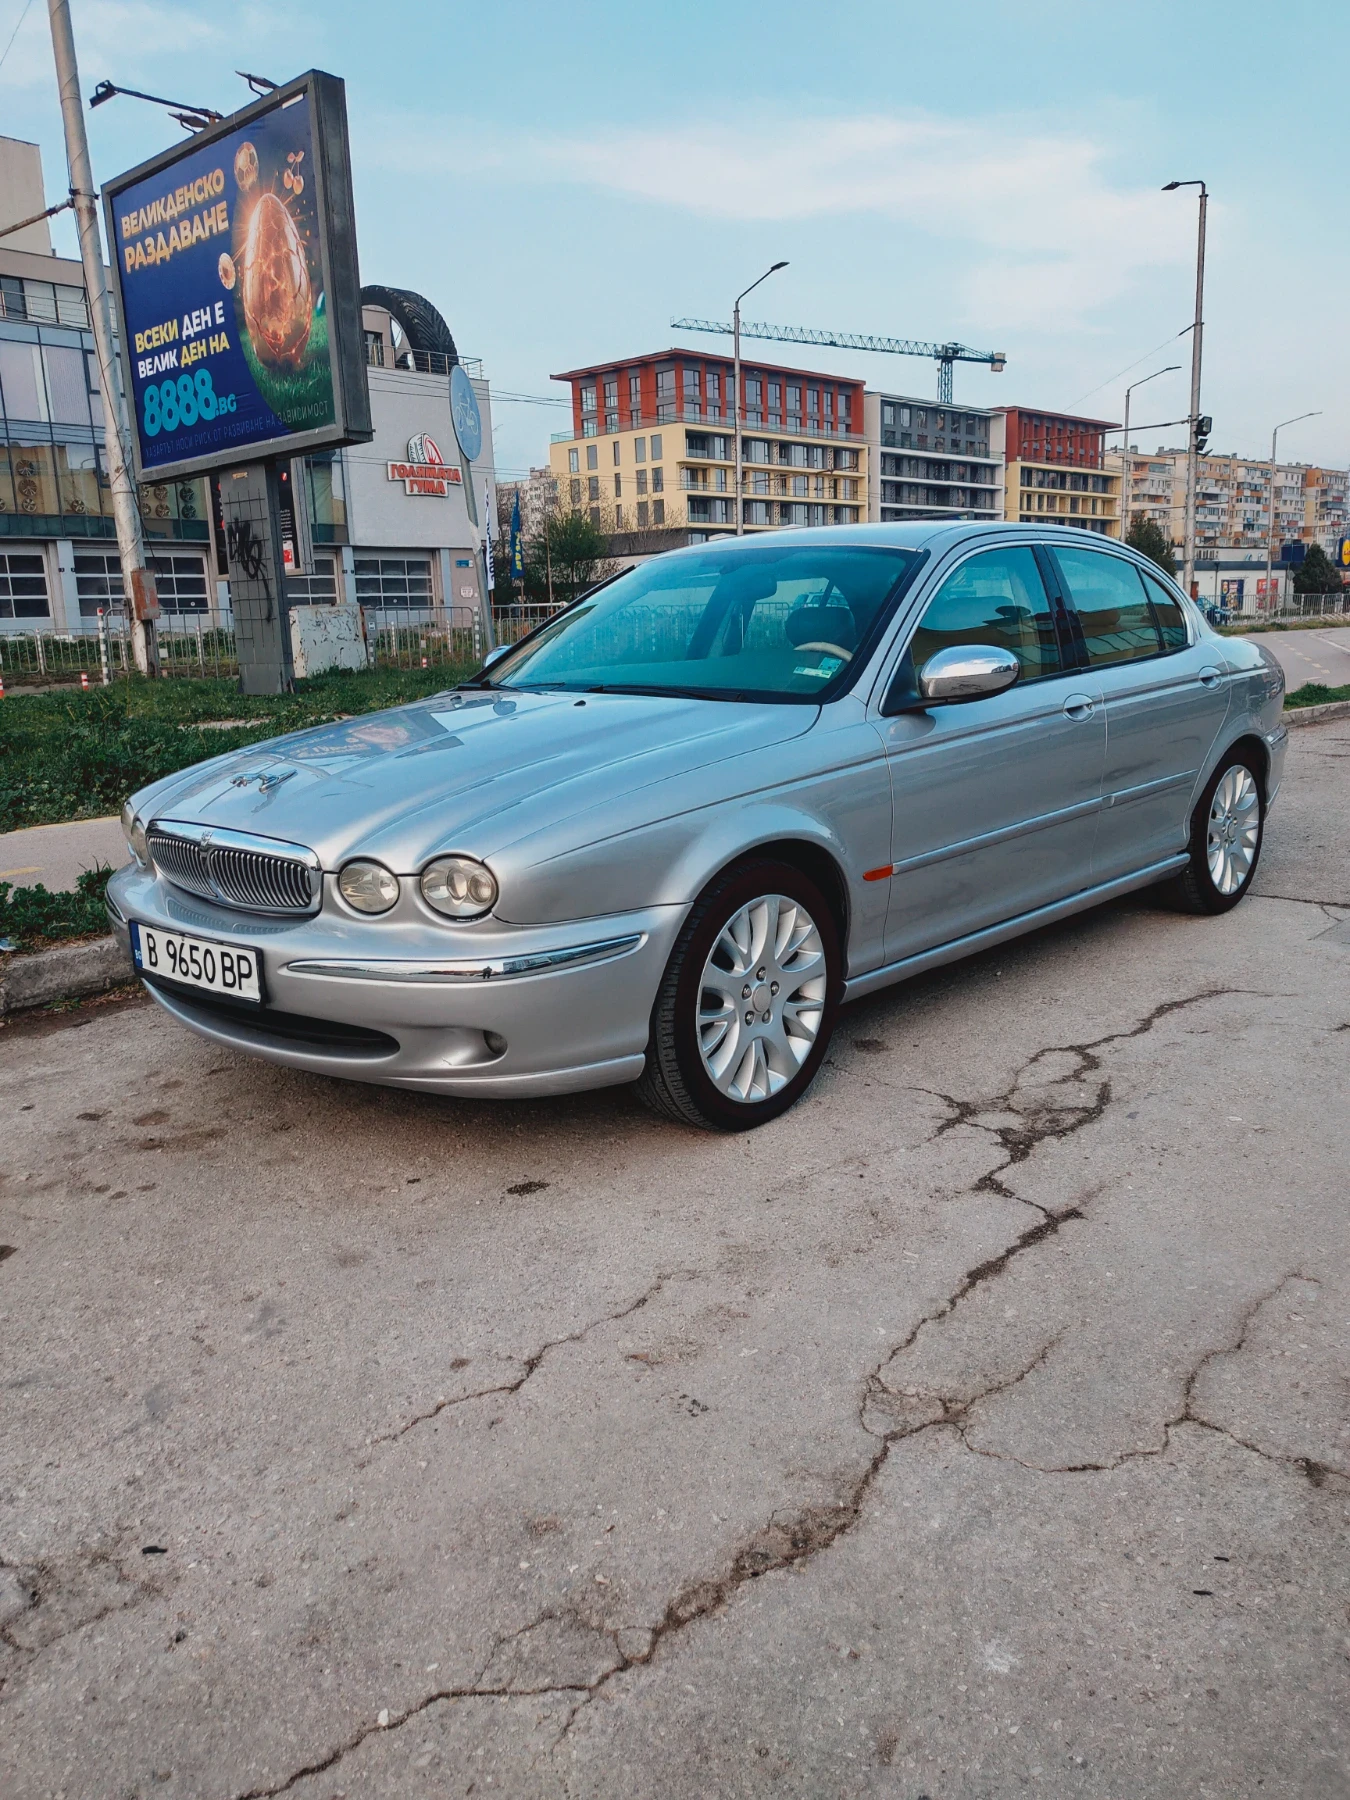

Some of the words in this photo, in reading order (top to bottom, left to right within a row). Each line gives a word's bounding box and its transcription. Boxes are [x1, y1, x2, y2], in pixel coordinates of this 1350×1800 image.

[121, 168, 225, 238] ВЕЛИКДЕНСКО
[124, 201, 229, 272] РАЗДАВАНЕ
[134, 318, 178, 353] ВСЕКИ
[181, 306, 212, 340] ДЕН
[215, 301, 224, 325] Е
[137, 348, 178, 379] ВЕЛИК
[180, 338, 207, 369] ДЕН
[209, 331, 230, 355] НА
[195, 433, 212, 446] РИСК
[213, 430, 221, 441] ОТ
[223, 420, 263, 439] РАЗВИВАНЕ
[266, 416, 276, 428] НА
[278, 400, 328, 426] ЗАВИСИМОСТ
[391, 463, 461, 482] ГОЛЯМАТА
[409, 479, 446, 495] ГУМА
[166, 939, 216, 984] 9650
